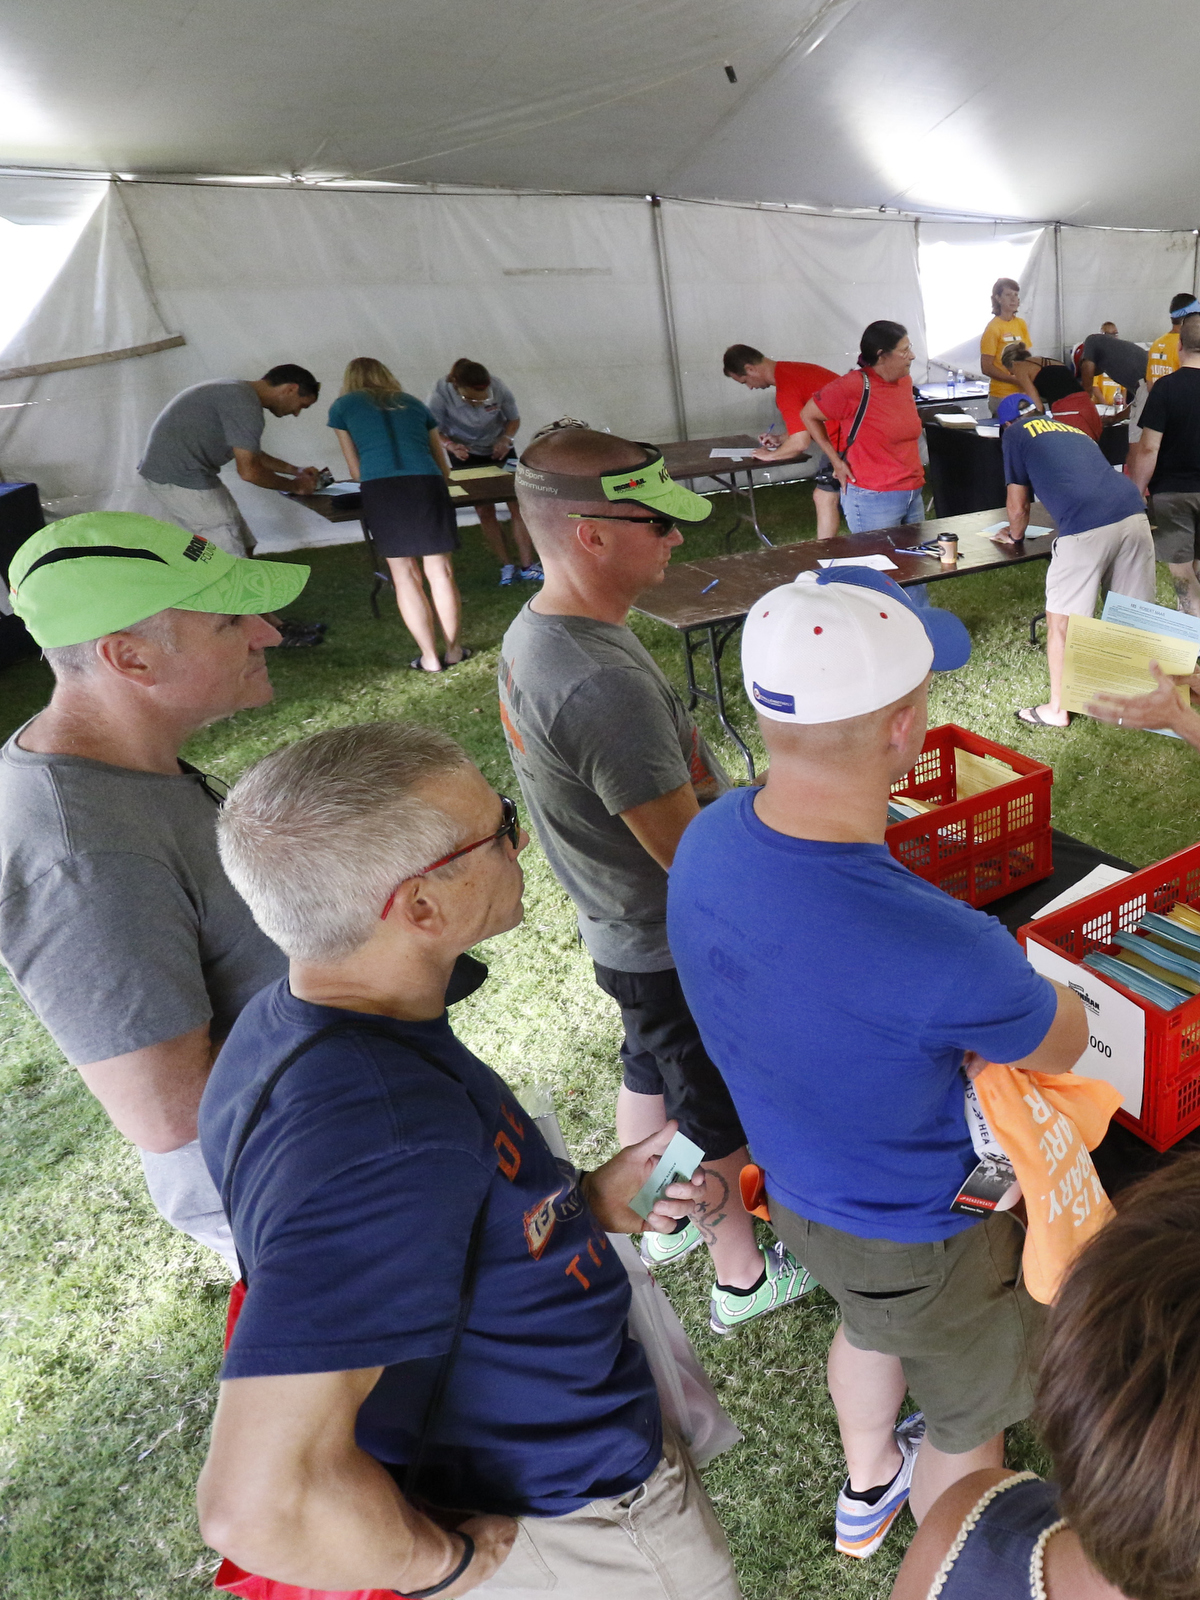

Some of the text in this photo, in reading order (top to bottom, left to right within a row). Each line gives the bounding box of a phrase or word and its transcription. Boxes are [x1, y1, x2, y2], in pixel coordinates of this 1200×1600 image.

[525, 469, 545, 482] Sport
[518, 478, 559, 495] Community
[1090, 1035, 1112, 1058] 000
